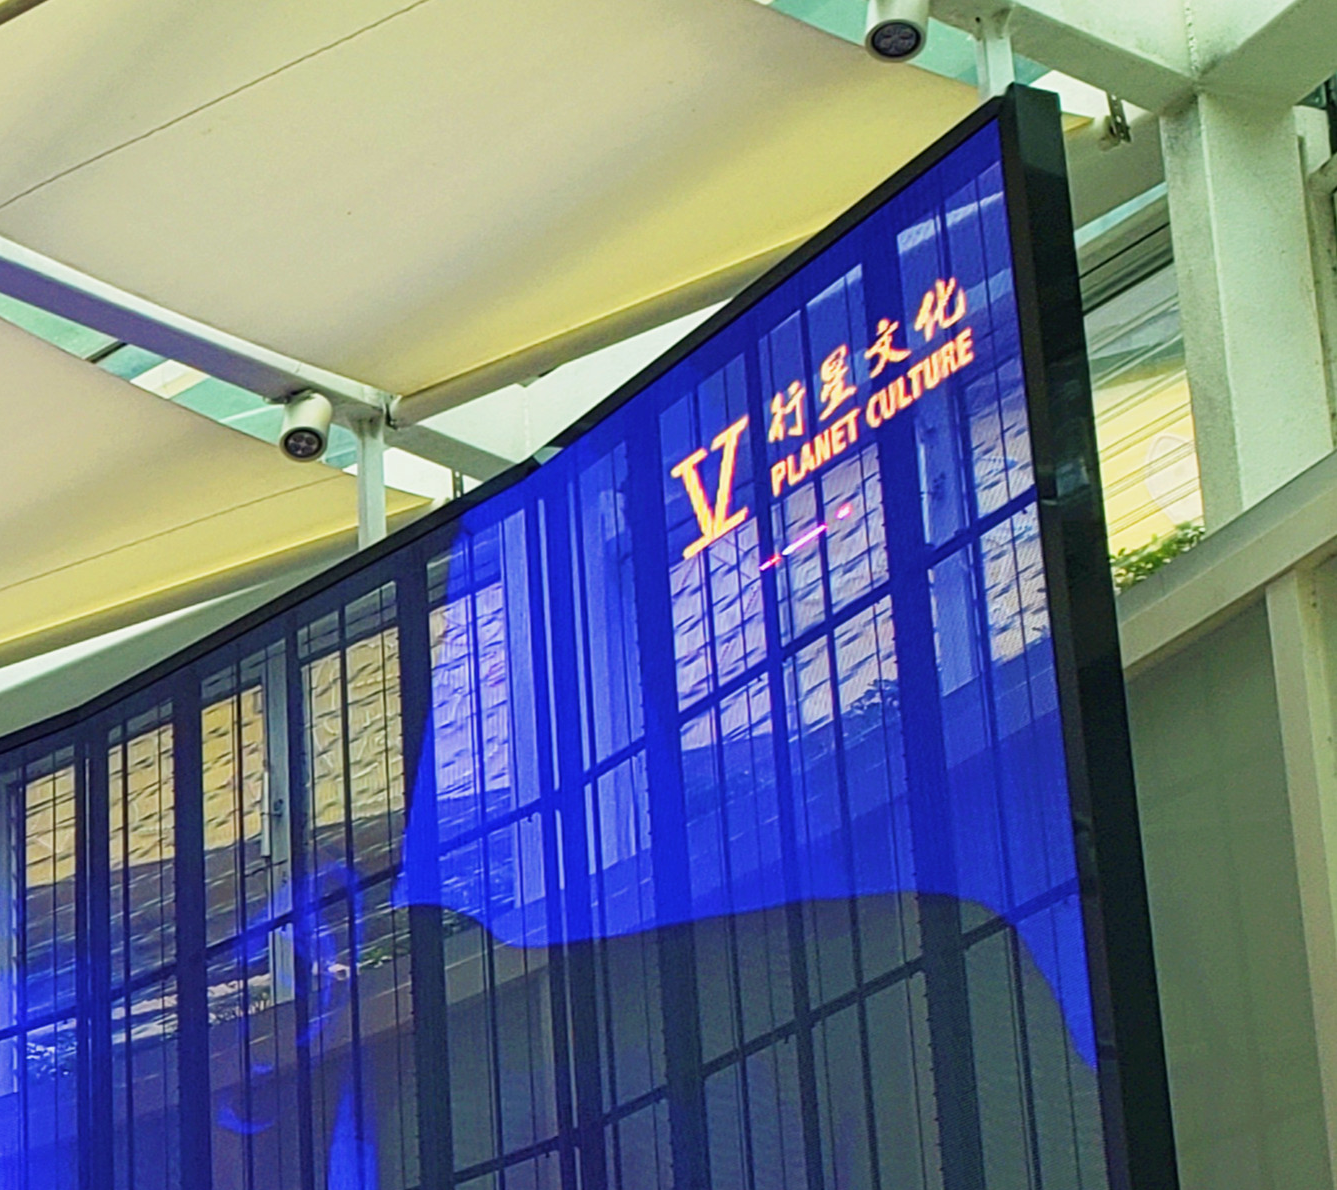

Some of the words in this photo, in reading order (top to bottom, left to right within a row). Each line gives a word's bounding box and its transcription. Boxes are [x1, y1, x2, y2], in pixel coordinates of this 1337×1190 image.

[767, 277, 967, 444] 行星文化
[771, 407, 861, 498] PLANET
[865, 327, 975, 429] CULTURE
